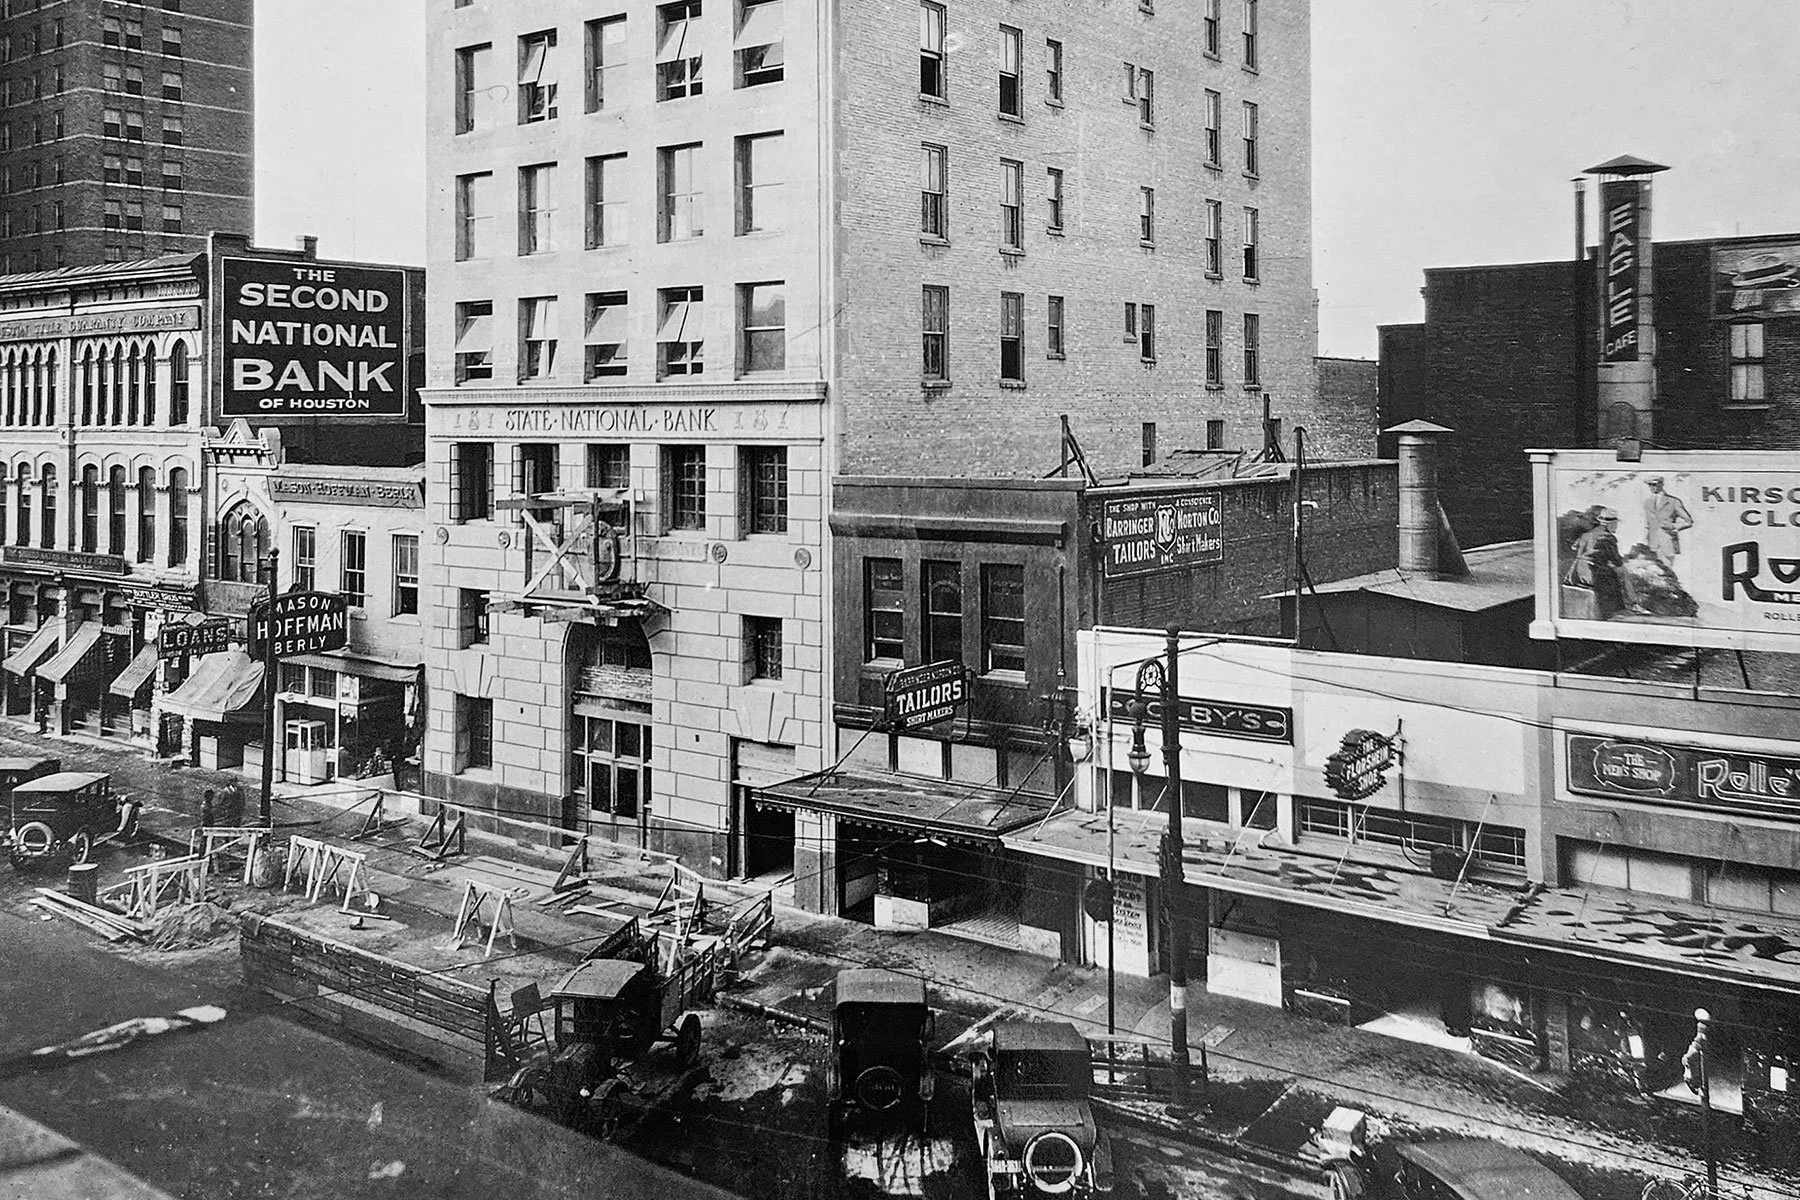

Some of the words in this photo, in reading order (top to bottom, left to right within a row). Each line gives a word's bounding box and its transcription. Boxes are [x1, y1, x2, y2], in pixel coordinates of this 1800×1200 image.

[292, 268, 336, 282] THE
[1609, 202, 1635, 327] EAGLE
[239, 282, 389, 312] SECOND
[133, 312, 186, 327] COMPANY
[232, 319, 397, 348] NATIONAL
[1606, 330, 1636, 355] CAFE
[233, 358, 396, 392] BANK
[259, 398, 284, 409] OF
[289, 398, 370, 409] HOUSTON
[505, 409, 553, 431] STATE
[562, 409, 653, 431] NATIONAL
[664, 408, 718, 432] BANK
[1122, 502, 1139, 513] SHOP
[1141, 501, 1156, 511] WITH
[1106, 517, 1154, 538] BARRINGER
[1177, 509, 1208, 530] NORTON
[1113, 539, 1156, 564] TAILORS
[1161, 553, 1174, 564] INC
[276, 596, 331, 614] MASON
[163, 627, 227, 648] LOANS
[257, 611, 343, 640] HOFFMAN
[274, 635, 327, 655] BERLY
[896, 679, 962, 715] TAILORS
[1126, 699, 1262, 730] OBY'S
[1624, 753, 1645, 767] THE
[1602, 763, 1630, 777] MEN'S
[1632, 767, 1662, 782] SHOP
